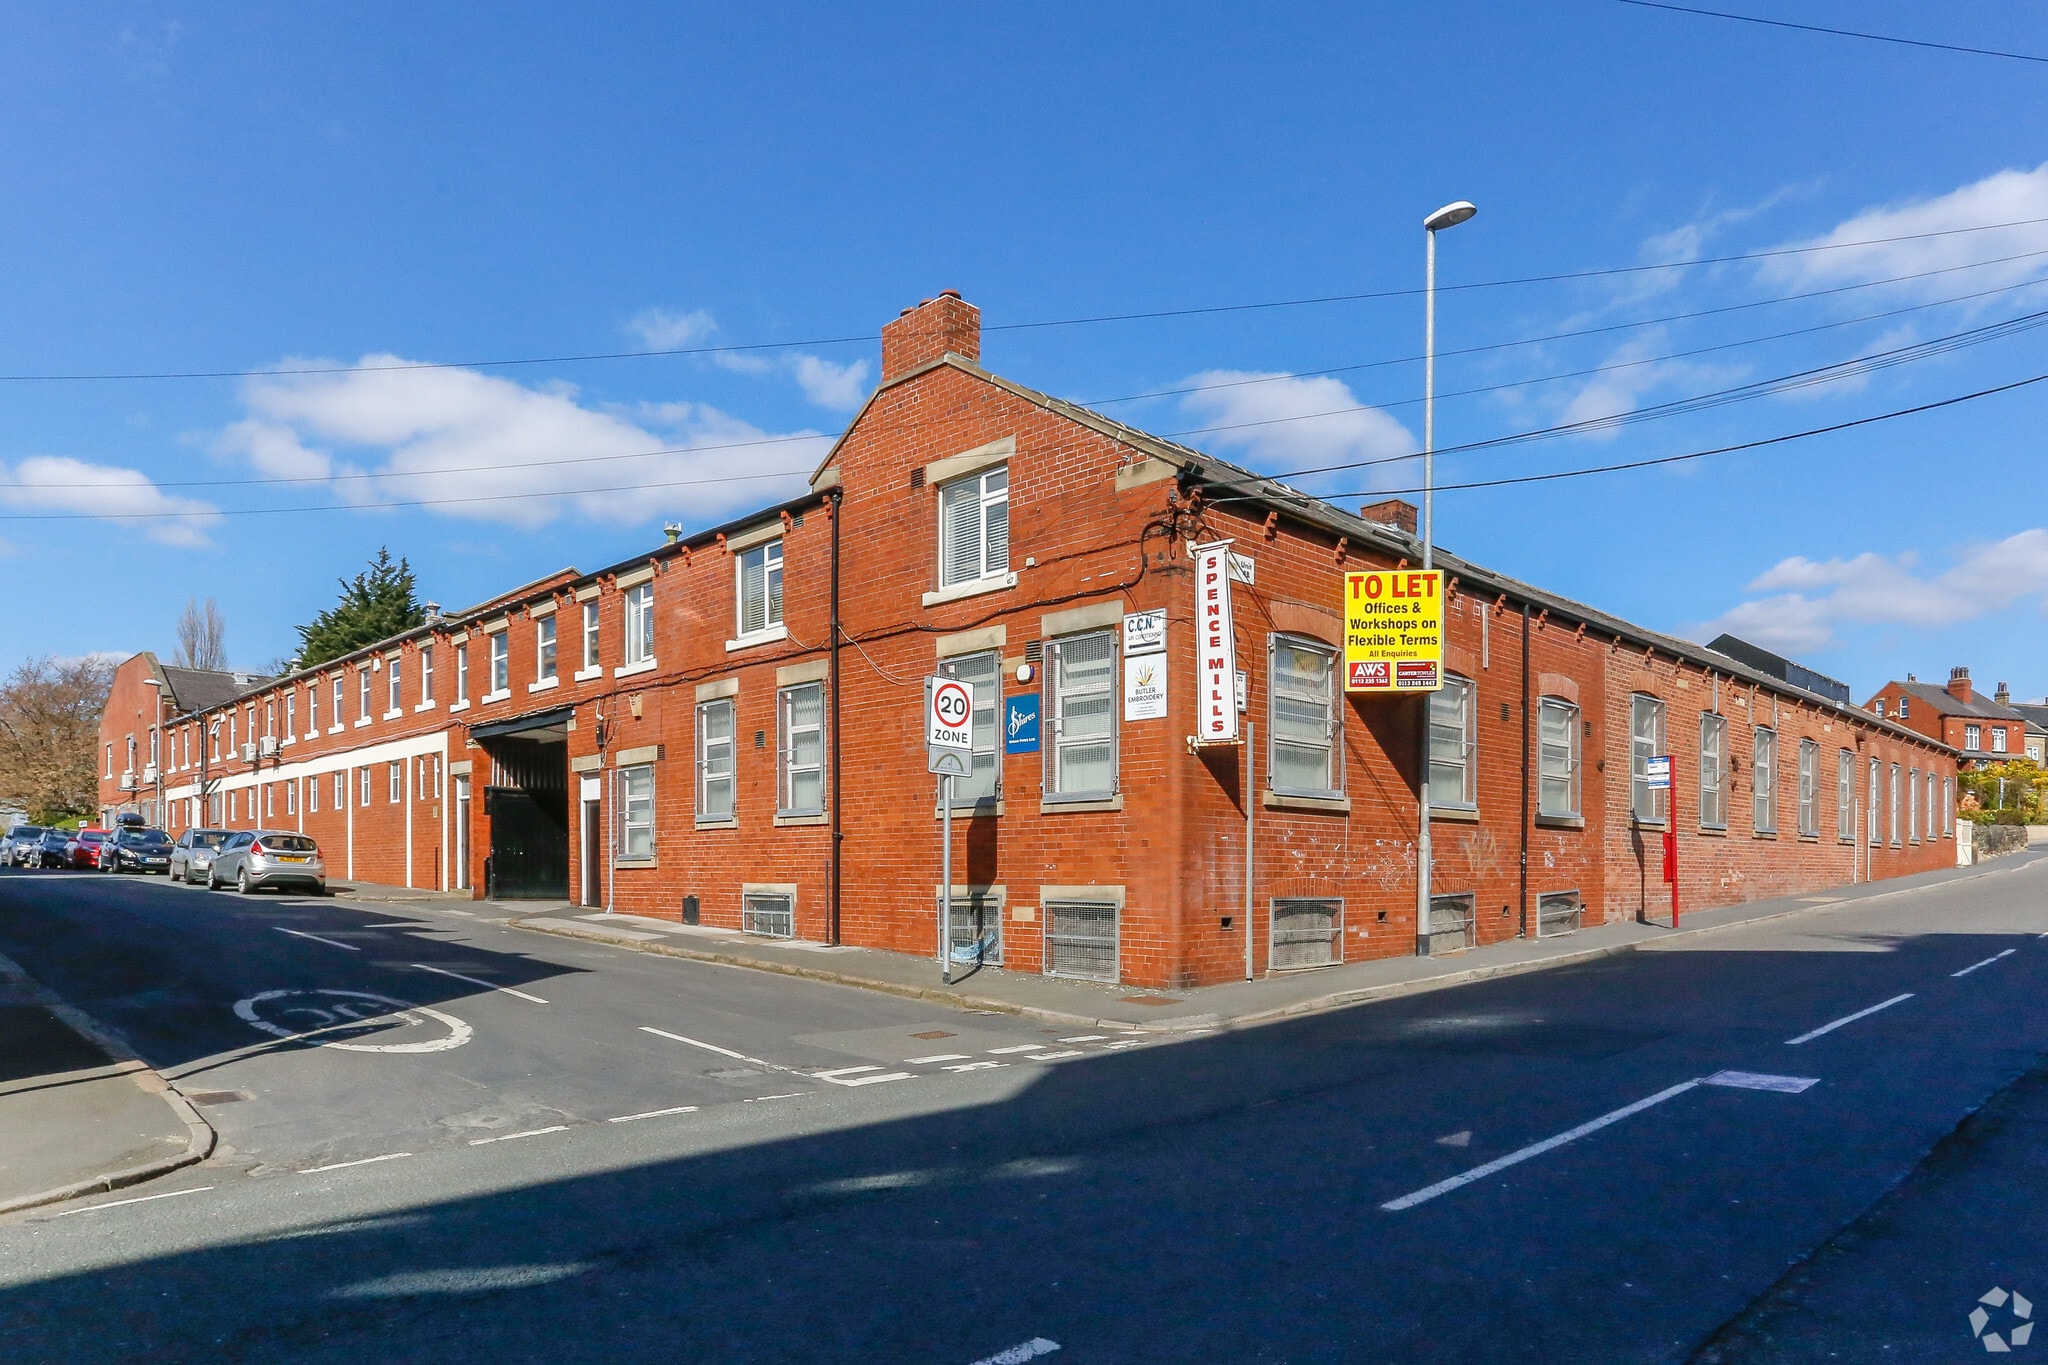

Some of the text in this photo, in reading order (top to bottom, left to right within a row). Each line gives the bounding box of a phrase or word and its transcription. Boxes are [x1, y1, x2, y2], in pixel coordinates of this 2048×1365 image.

[1241, 560, 1252, 571] Unit
[1349, 574, 1438, 599] TO LET
[1365, 602, 1421, 613] Offices &
[1128, 617, 1155, 632] C.C.N.
[1350, 618, 1437, 632] Workshops on
[1206, 557, 1224, 732] SPENCE MILLS
[1348, 634, 1438, 646] Flexible Terms
[1381, 650, 1418, 658] Enquiries
[1354, 663, 1386, 677] AWS
[1128, 693, 1163, 703] EMBROIDERY
[1135, 687, 1156, 695] BUTLER
[941, 695, 965, 716] 20
[934, 728, 968, 744] ZONE
